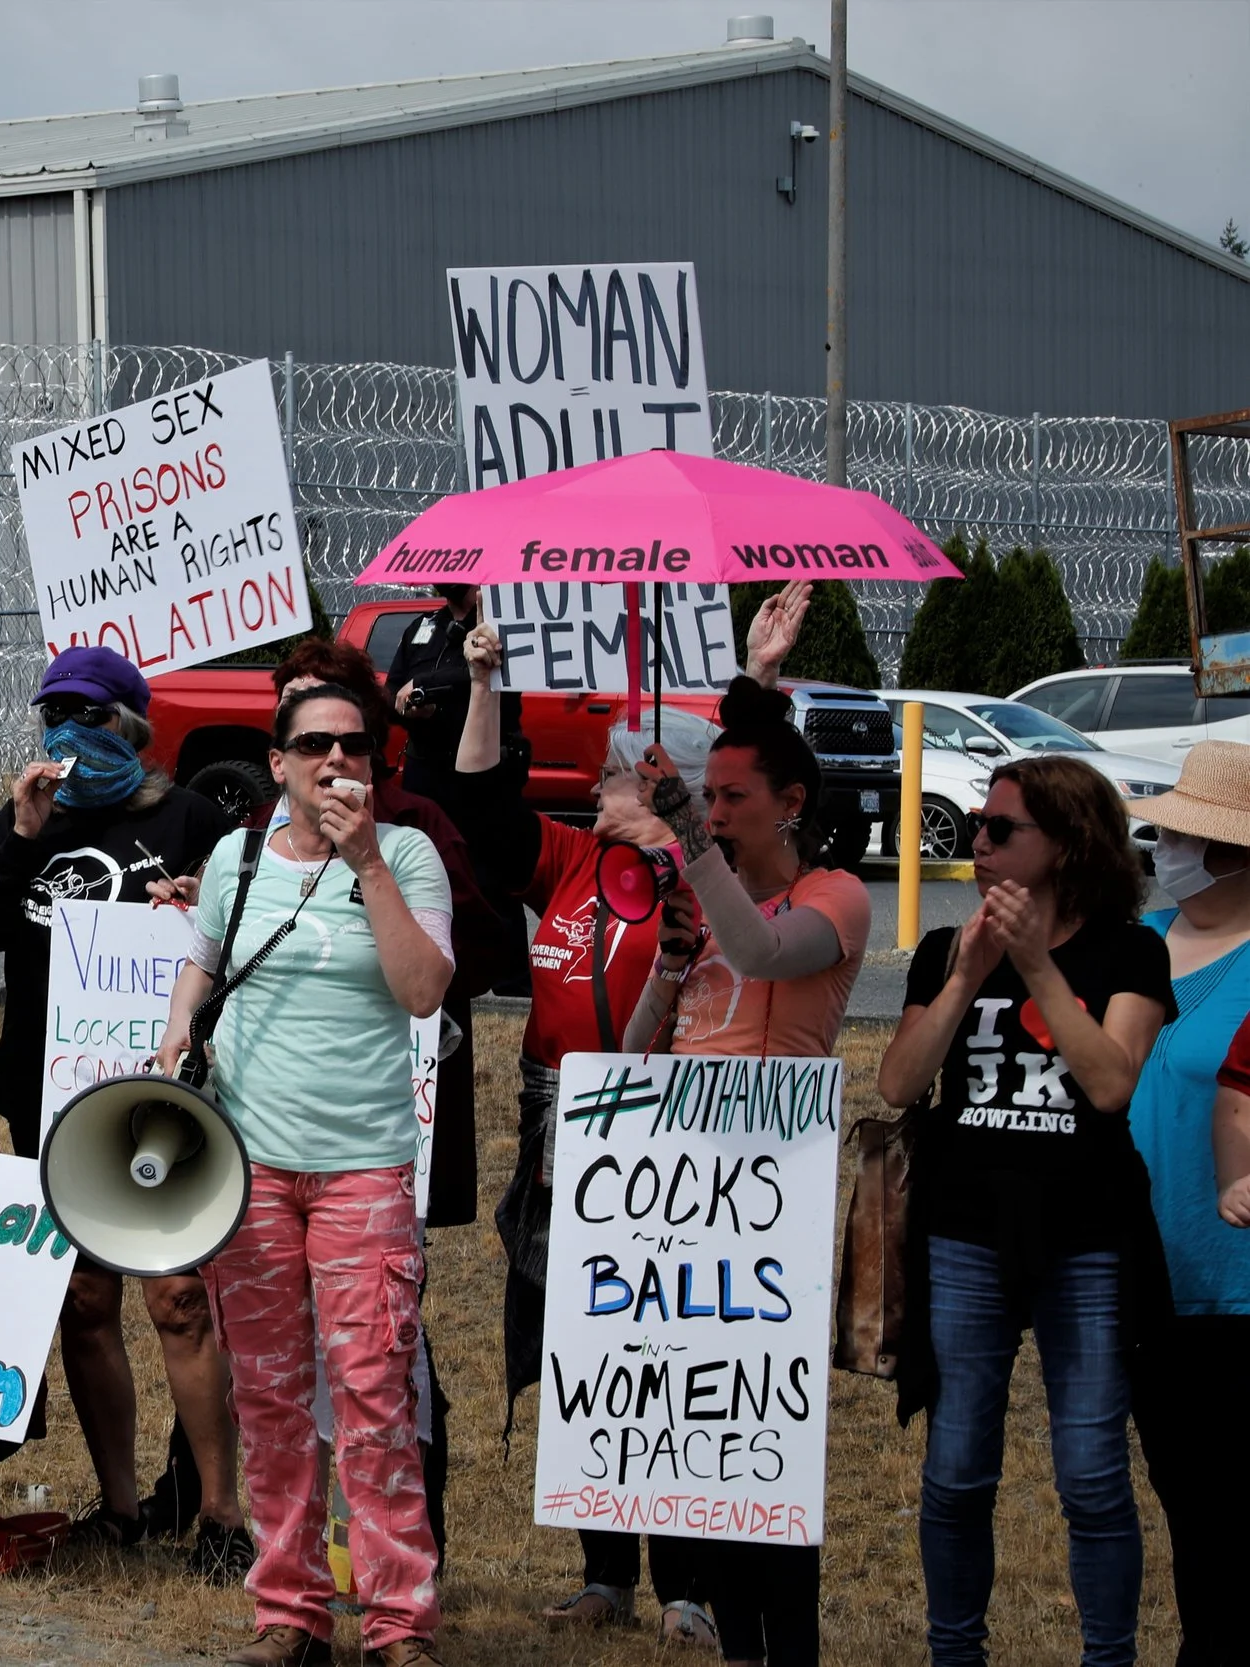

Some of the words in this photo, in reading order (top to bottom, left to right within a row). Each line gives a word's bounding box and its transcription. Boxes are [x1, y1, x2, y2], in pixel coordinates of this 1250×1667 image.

[450, 269, 689, 390] WOMAN
[21, 417, 126, 490] MIXED
[151, 381, 223, 445] SEX
[68, 442, 226, 539] PRISONS
[47, 556, 157, 620] HUMAN
[180, 511, 284, 584] RIGHTS
[110, 519, 160, 562] ARE
[173, 511, 193, 541] A
[384, 541, 484, 574] human
[520, 540, 691, 572] female
[730, 541, 889, 570] woman
[47, 566, 298, 669] OLATION
[498, 601, 734, 692] FEMALE
[129, 855, 164, 873] SPEAK
[532, 956, 562, 970] WOMEN
[55, 1005, 168, 1051] LOCKED
[966, 997, 1014, 1049] I
[957, 1106, 1077, 1134] ROWLING
[574, 1153, 783, 1236] COCKS
[581, 1254, 792, 1323] BALLS
[550, 1351, 810, 1431] WOMENS
[581, 1426, 784, 1485] SPACES
[541, 1483, 809, 1545] #SEXNOTGENDER
